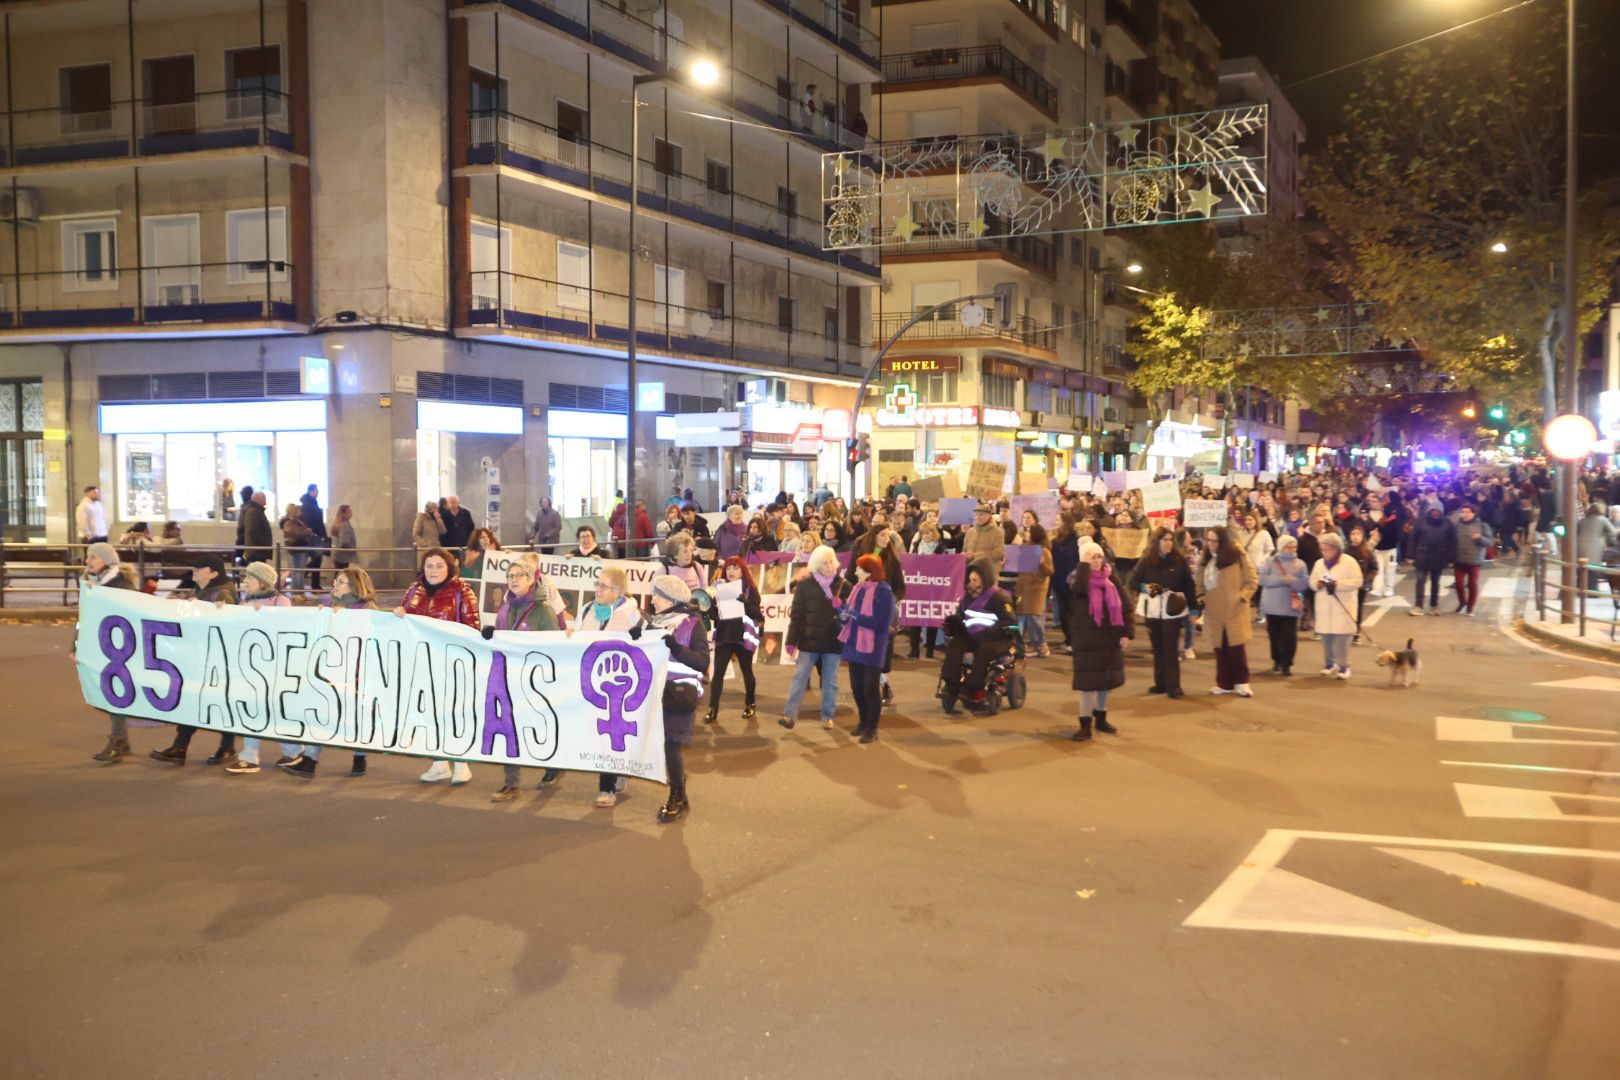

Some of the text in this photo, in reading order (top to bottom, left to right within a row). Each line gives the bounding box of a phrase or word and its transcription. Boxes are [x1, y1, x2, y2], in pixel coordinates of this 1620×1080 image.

[891, 361, 939, 371] HOTEL
[540, 562, 602, 578] UEREMO
[98, 615, 559, 761] 85 ASESINADAS
